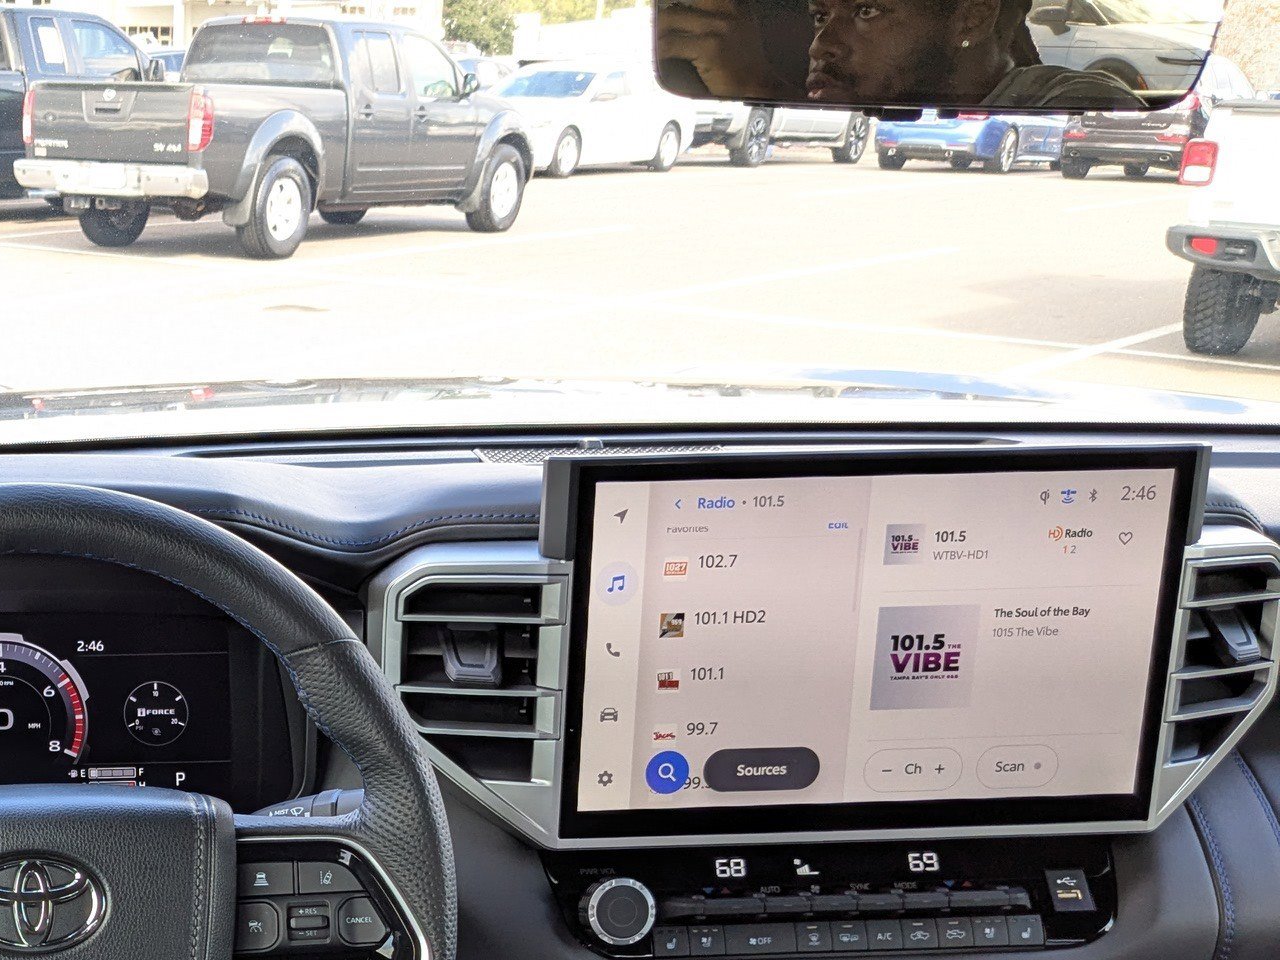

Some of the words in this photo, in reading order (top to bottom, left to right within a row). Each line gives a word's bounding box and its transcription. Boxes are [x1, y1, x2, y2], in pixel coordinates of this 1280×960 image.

[1121, 486, 1156, 501] 2:46
[697, 497, 735, 509] Radio
[752, 496, 785, 507] 101.5
[935, 531, 966, 543] 101.5
[1065, 528, 1093, 538] Radio
[891, 542, 919, 551] VIBE
[933, 550, 988, 560] WTBV-HD1
[699, 555, 737, 568] 102.7
[694, 612, 728, 625] 101.1
[733, 610, 766, 623] HD2
[995, 608, 1012, 618] The
[1015, 607, 1038, 617] Soul
[1040, 607, 1051, 617] of
[1053, 607, 1070, 617] the
[1072, 607, 1090, 618] Bay
[992, 628, 1013, 637] 1015
[1016, 627, 1034, 637] The
[1036, 627, 1059, 636] Vibe
[77, 640, 104, 652] 2:46
[891, 634, 945, 651] 101.5
[890, 652, 960, 673] VIBE
[690, 667, 724, 681] 101.1
[43, 686, 55, 697] 6
[686, 722, 718, 735] 99.7
[48, 740, 61, 752] 8
[139, 768, 144, 776] F
[736, 764, 787, 777] Sources
[905, 763, 922, 775] Ch
[995, 761, 1025, 772] Scan
[80, 769, 86, 778] E
[175, 772, 186, 786] P
[715, 858, 746, 878] 68
[908, 852, 940, 872] 69
[760, 886, 780, 894] AUTO
[849, 882, 870, 891] SYNC
[894, 881, 917, 889] MODE
[877, 932, 892, 941] A/C
